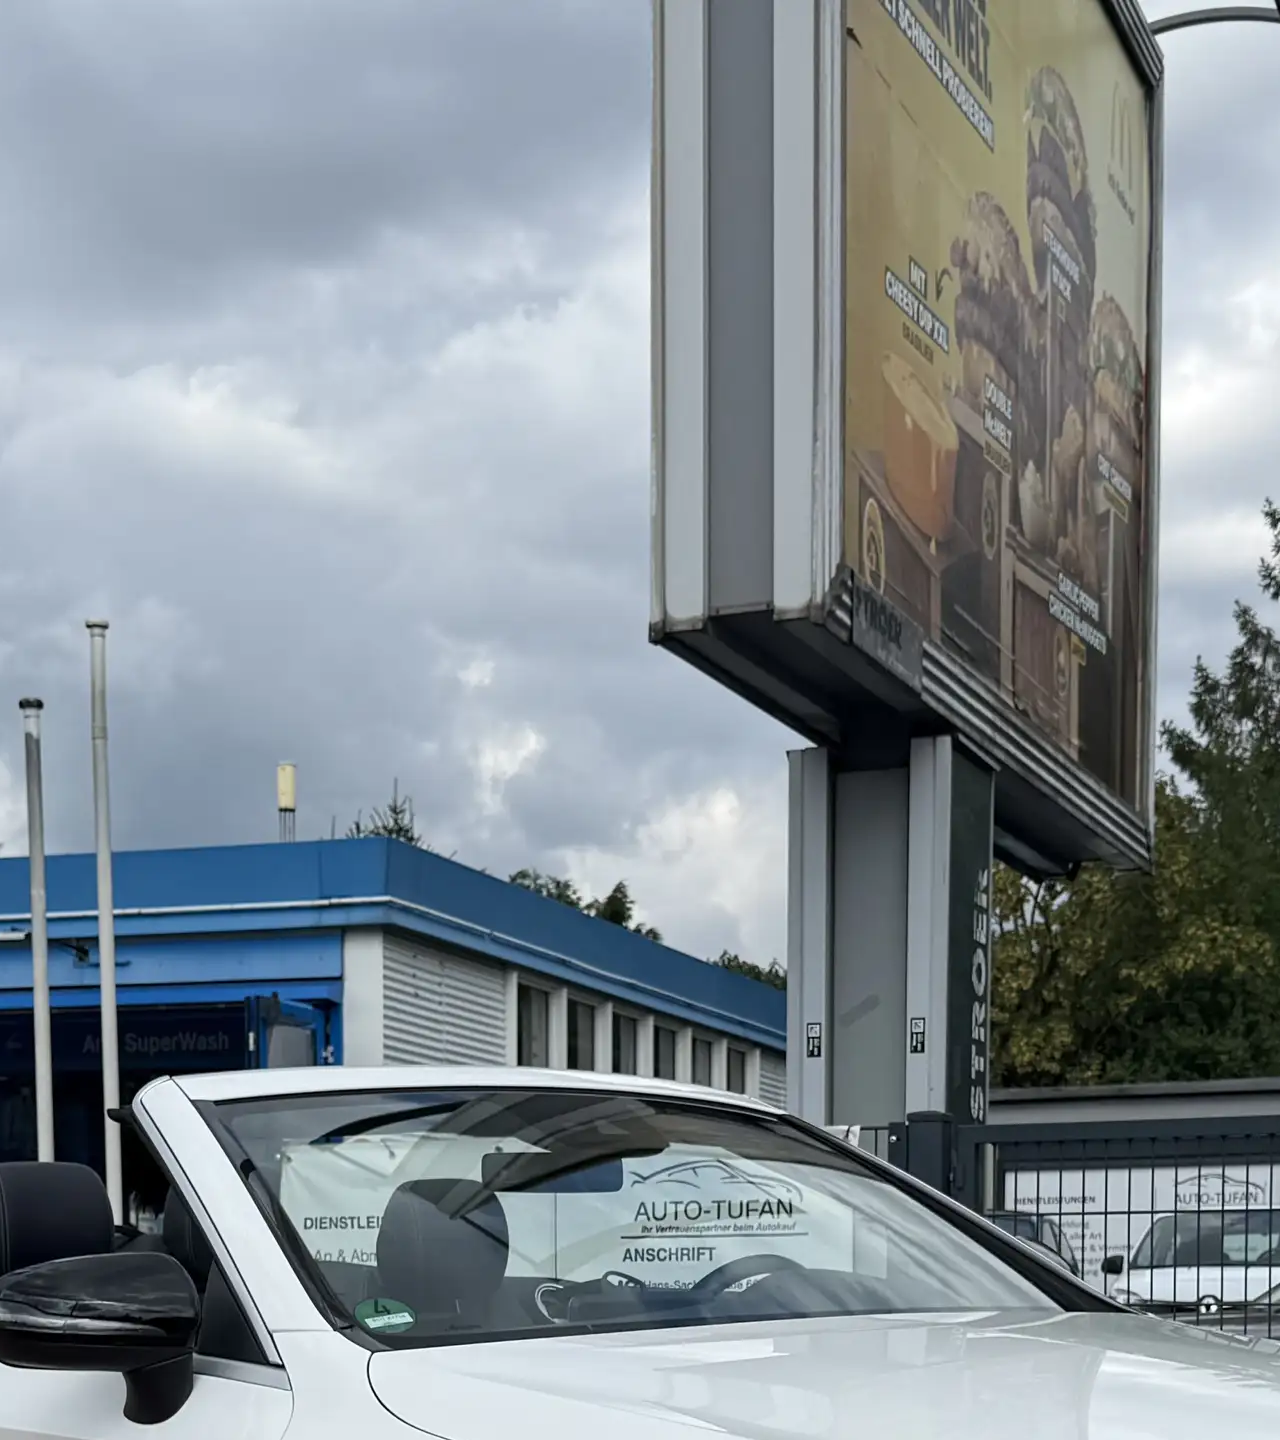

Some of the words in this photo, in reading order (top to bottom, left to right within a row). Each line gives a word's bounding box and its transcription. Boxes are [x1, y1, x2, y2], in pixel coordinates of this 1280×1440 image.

[124, 1031, 229, 1055] SuperWash
[634, 1199, 793, 1222] AUTO-TUFAN
[304, 1216, 383, 1230] DIENSTLEI
[641, 1225, 653, 1233] Ihr
[733, 1223, 754, 1232] beim
[756, 1221, 797, 1231] Autokauf
[622, 1247, 717, 1262] ANSCHRIFT
